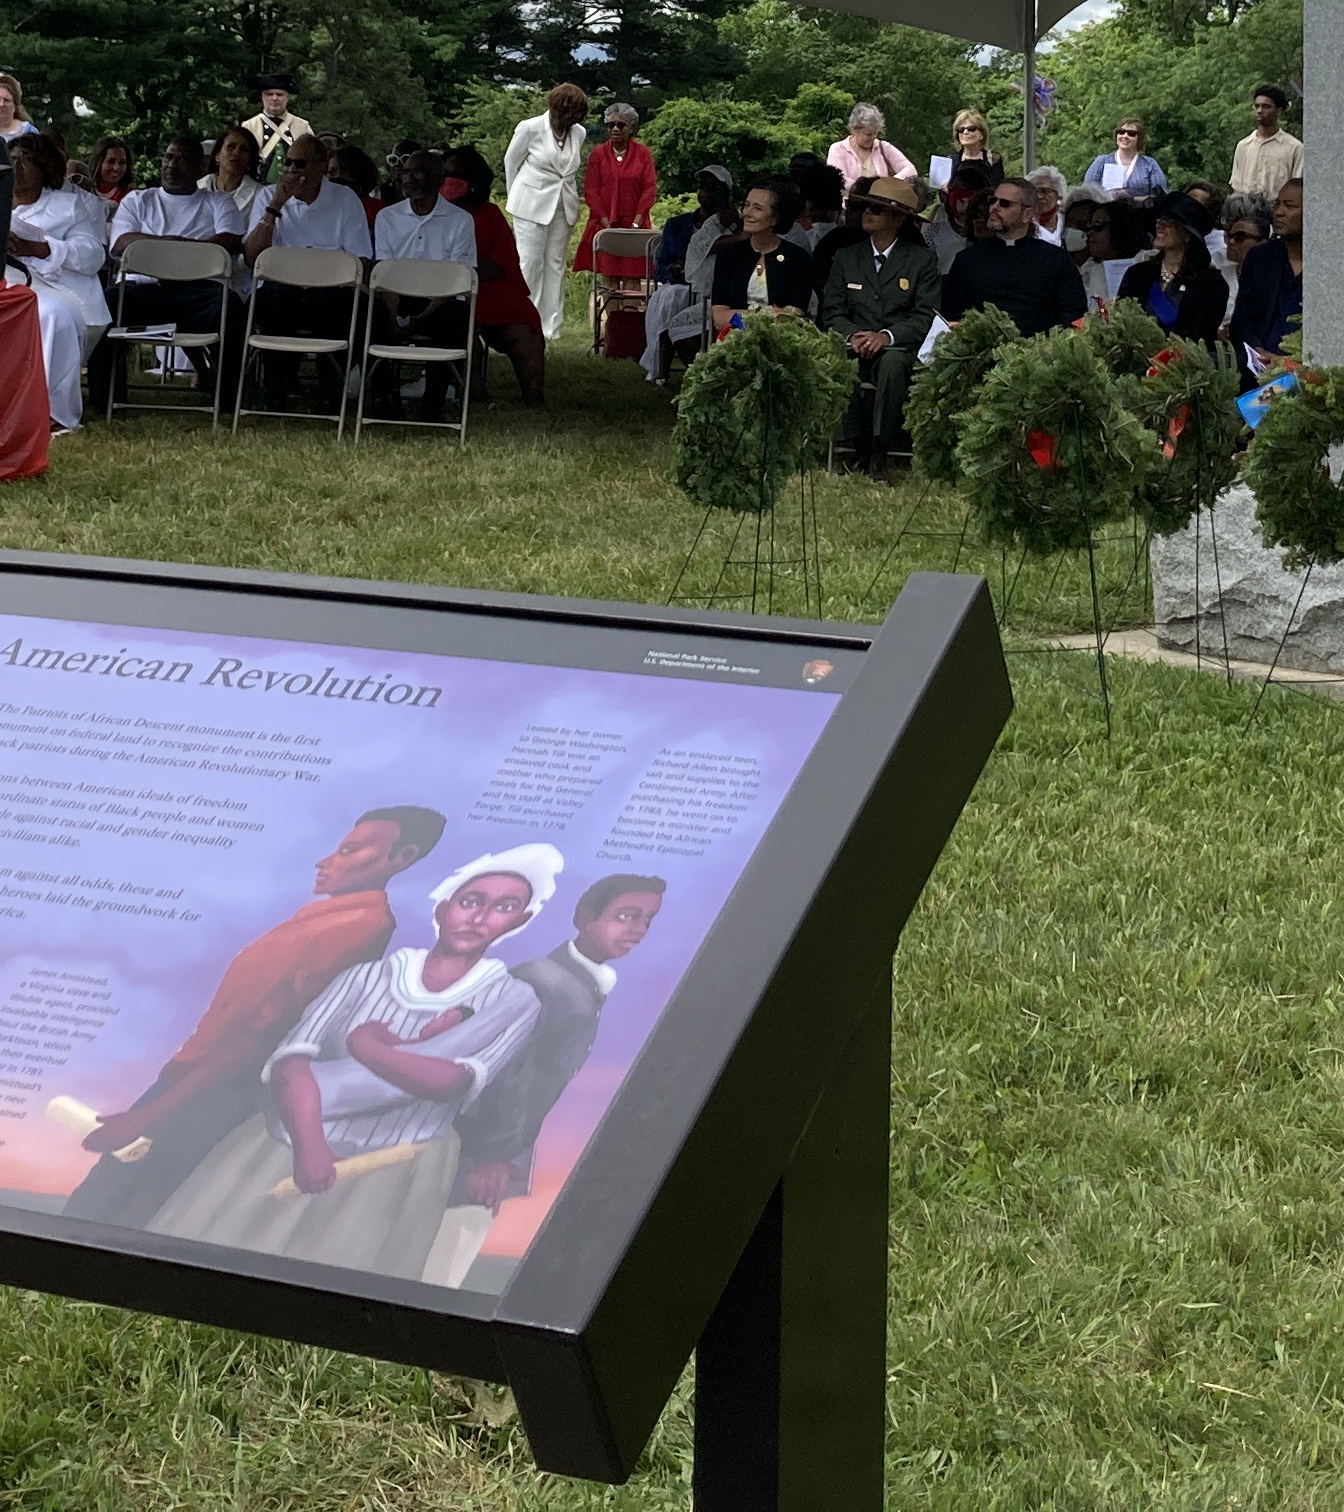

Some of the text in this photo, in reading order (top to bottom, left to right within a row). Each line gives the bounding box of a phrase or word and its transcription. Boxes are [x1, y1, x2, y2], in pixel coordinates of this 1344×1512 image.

[198, 657, 442, 707] Revolution
[21, 705, 68, 718] Patriots
[70, 711, 88, 720] of
[84, 712, 131, 726] African
[133, 717, 185, 731] Descent
[185, 725, 255, 739] monument
[256, 730, 268, 740] is
[269, 731, 291, 743] the
[292, 734, 321, 746] first
[16, 742, 68, 753] patriots
[68, 745, 112, 760] during
[112, 750, 133, 760] the
[134, 752, 196, 768] American
[198, 759, 290, 780] Revolutionary
[49, 728, 67, 736] on
[67, 728, 113, 741] federal
[112, 732, 143, 744] land
[142, 737, 156, 746] to
[157, 740, 219, 752] recognize
[220, 744, 242, 756] the
[244, 749, 332, 765] contributions
[19, 774, 72, 790] between
[72, 781, 135, 798] American
[136, 788, 174, 802] ideals
[176, 793, 194, 804] of
[192, 795, 248, 811] freedom
[12, 813, 59, 825] against
[58, 818, 98, 830] racial
[95, 822, 124, 833] and
[120, 826, 170, 838] gender
[170, 830, 237, 849] inequality
[49, 799, 87, 810] status
[88, 801, 107, 812] of
[104, 803, 139, 816] Black
[139, 810, 186, 824] people
[187, 815, 216, 826] and
[216, 818, 264, 832] women
[47, 834, 84, 846] alike.
[13, 870, 60, 884] against
[60, 874, 81, 885] all
[79, 877, 114, 892] odds,
[118, 881, 154, 895] these
[154, 888, 184, 899] and
[43, 890, 72, 904] laid
[70, 895, 93, 907] the
[91, 900, 178, 919] groundwork
[179, 909, 202, 921] for
